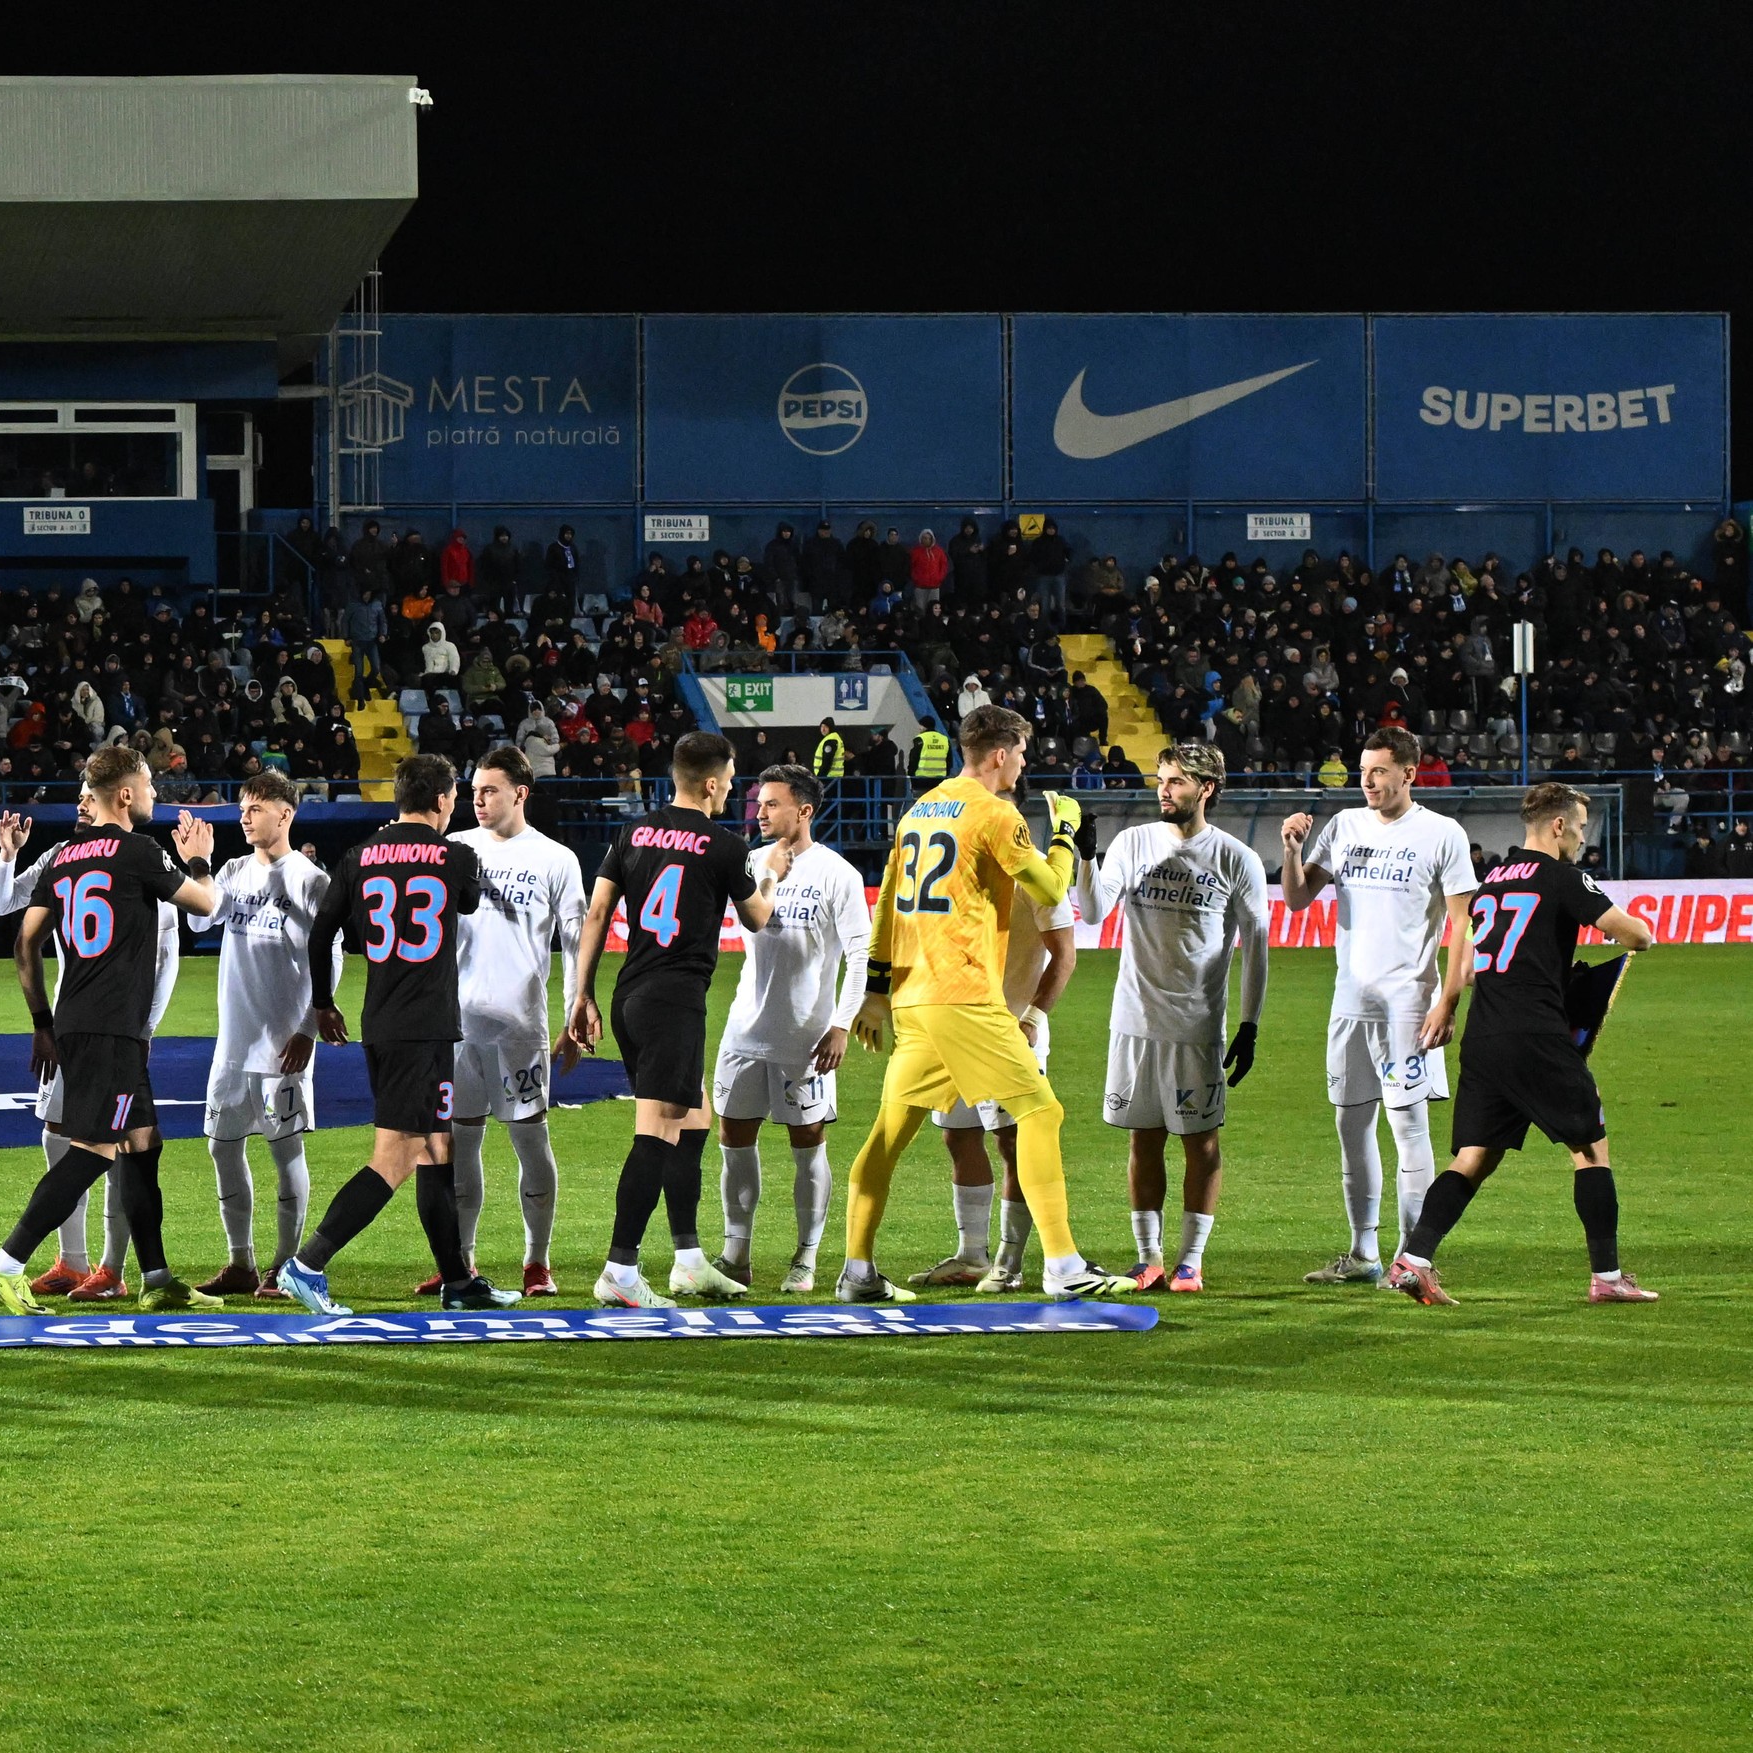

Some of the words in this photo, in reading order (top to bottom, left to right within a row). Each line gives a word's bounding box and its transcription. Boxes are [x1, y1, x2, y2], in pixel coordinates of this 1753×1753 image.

[428, 375, 593, 415] MESTA
[783, 399, 863, 419] PEPSI
[1419, 384, 1677, 433] SUPERBET
[427, 426, 500, 449] piatră
[514, 425, 621, 446] naturală
[29, 510, 73, 520] TRIBUNA
[651, 518, 693, 528] TRIBUNA
[1253, 516, 1295, 526] TRIBUNA
[660, 532, 684, 540] SECTOR
[1262, 530, 1286, 538] SECTOR
[745, 682, 772, 697] EXIT
[631, 826, 711, 856] GRAOVAC
[1341, 843, 1393, 859] Alături
[1396, 847, 1416, 862] de
[360, 843, 448, 867] RADUNOVIC
[516, 870, 537, 885] de
[896, 830, 958, 914] 32
[1136, 863, 1192, 883] Alături
[1196, 872, 1217, 888] de
[1340, 860, 1413, 883] Amelia!
[1484, 862, 1540, 884] OLARU
[272, 894, 292, 911] de
[801, 885, 821, 902] de
[1133, 880, 1213, 907] Amelia!
[53, 869, 115, 959] 16
[639, 863, 685, 949] 4
[361, 876, 448, 963] 33
[1472, 892, 1541, 973] 27
[281, 1086, 295, 1112] 7
[43, 1320, 241, 1335] de
[304, 1309, 916, 1333] Amelia!
